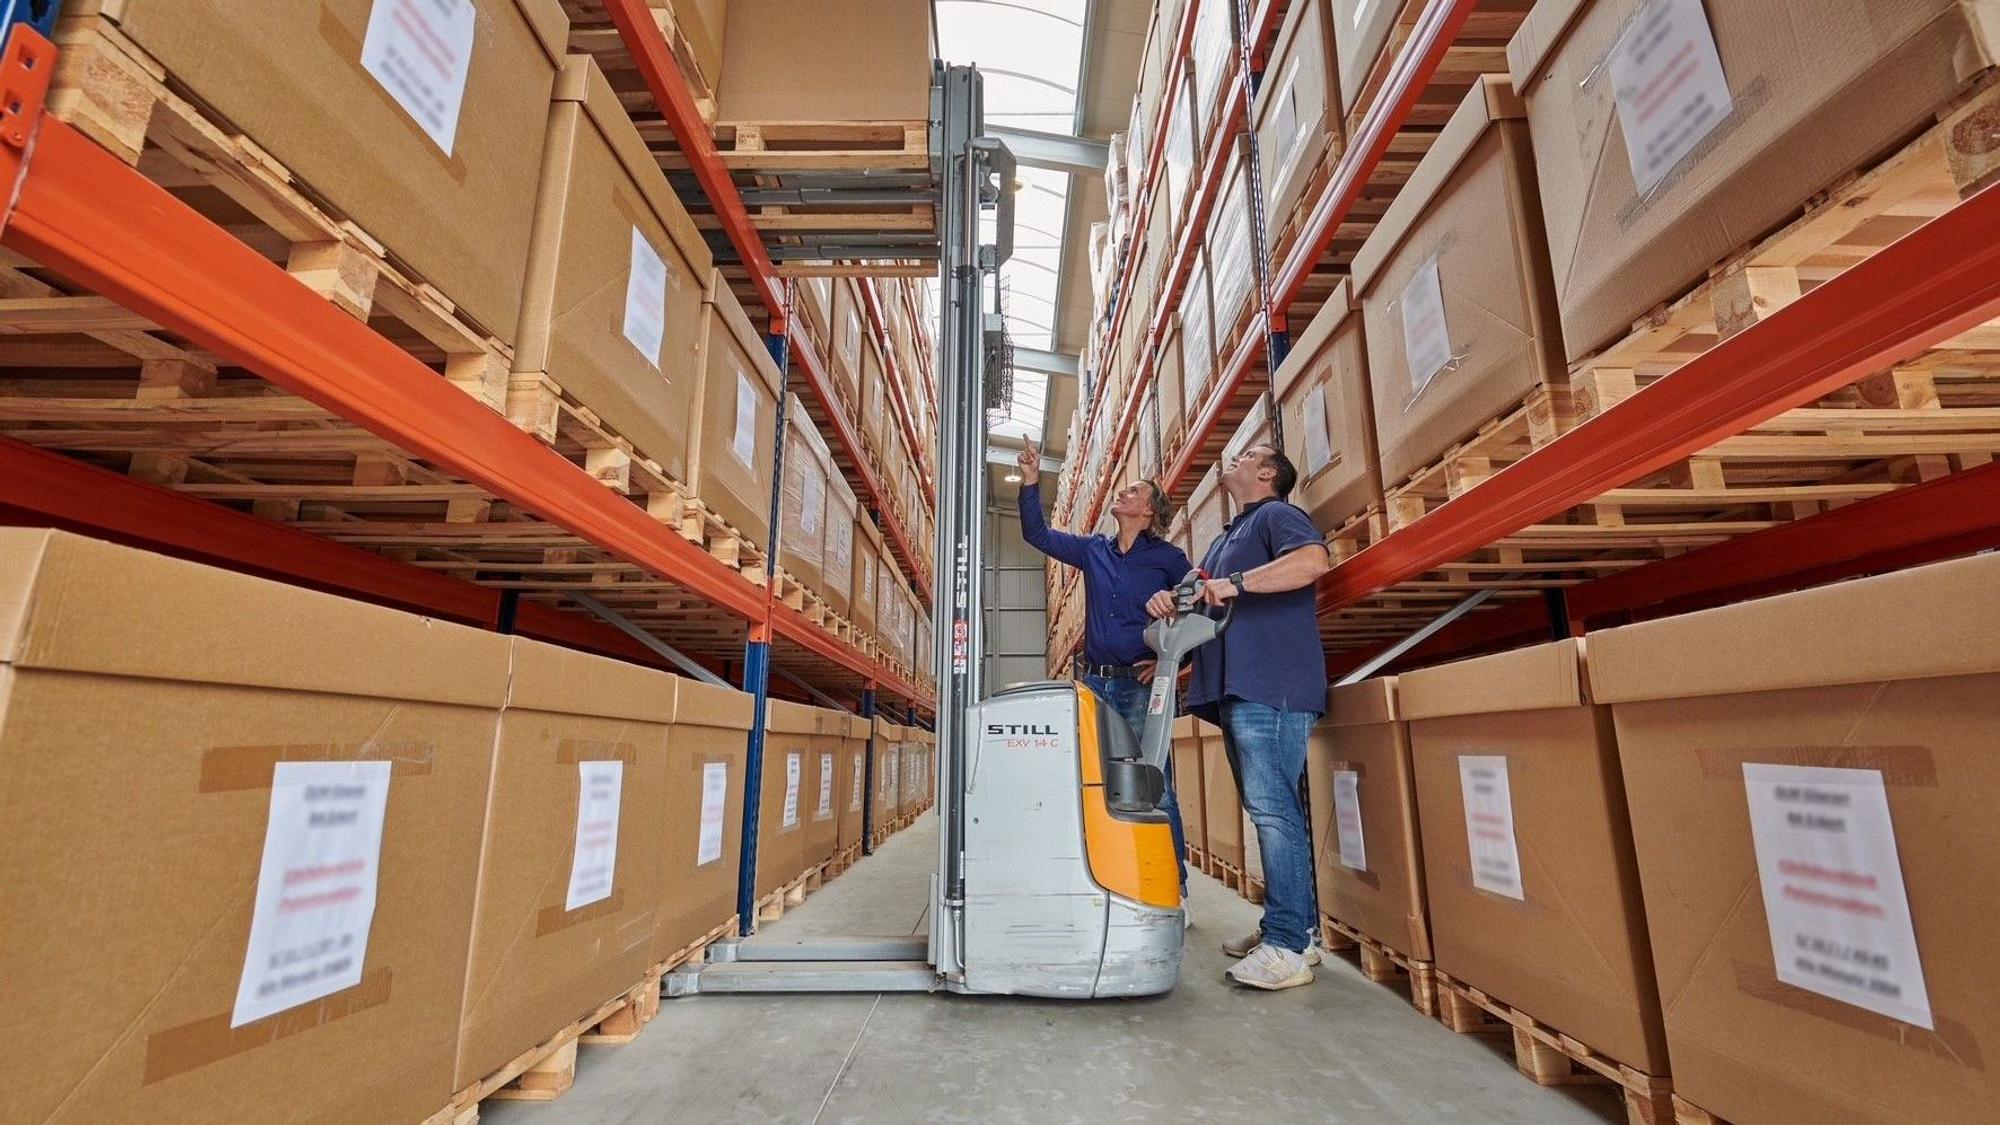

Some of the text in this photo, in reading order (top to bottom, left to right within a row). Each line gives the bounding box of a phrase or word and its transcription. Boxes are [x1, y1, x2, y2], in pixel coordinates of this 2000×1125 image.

[956, 535, 968, 609] STILL
[987, 724, 1059, 735] STILL
[1007, 739, 1032, 748] EXV
[1050, 739, 1058, 748] C
